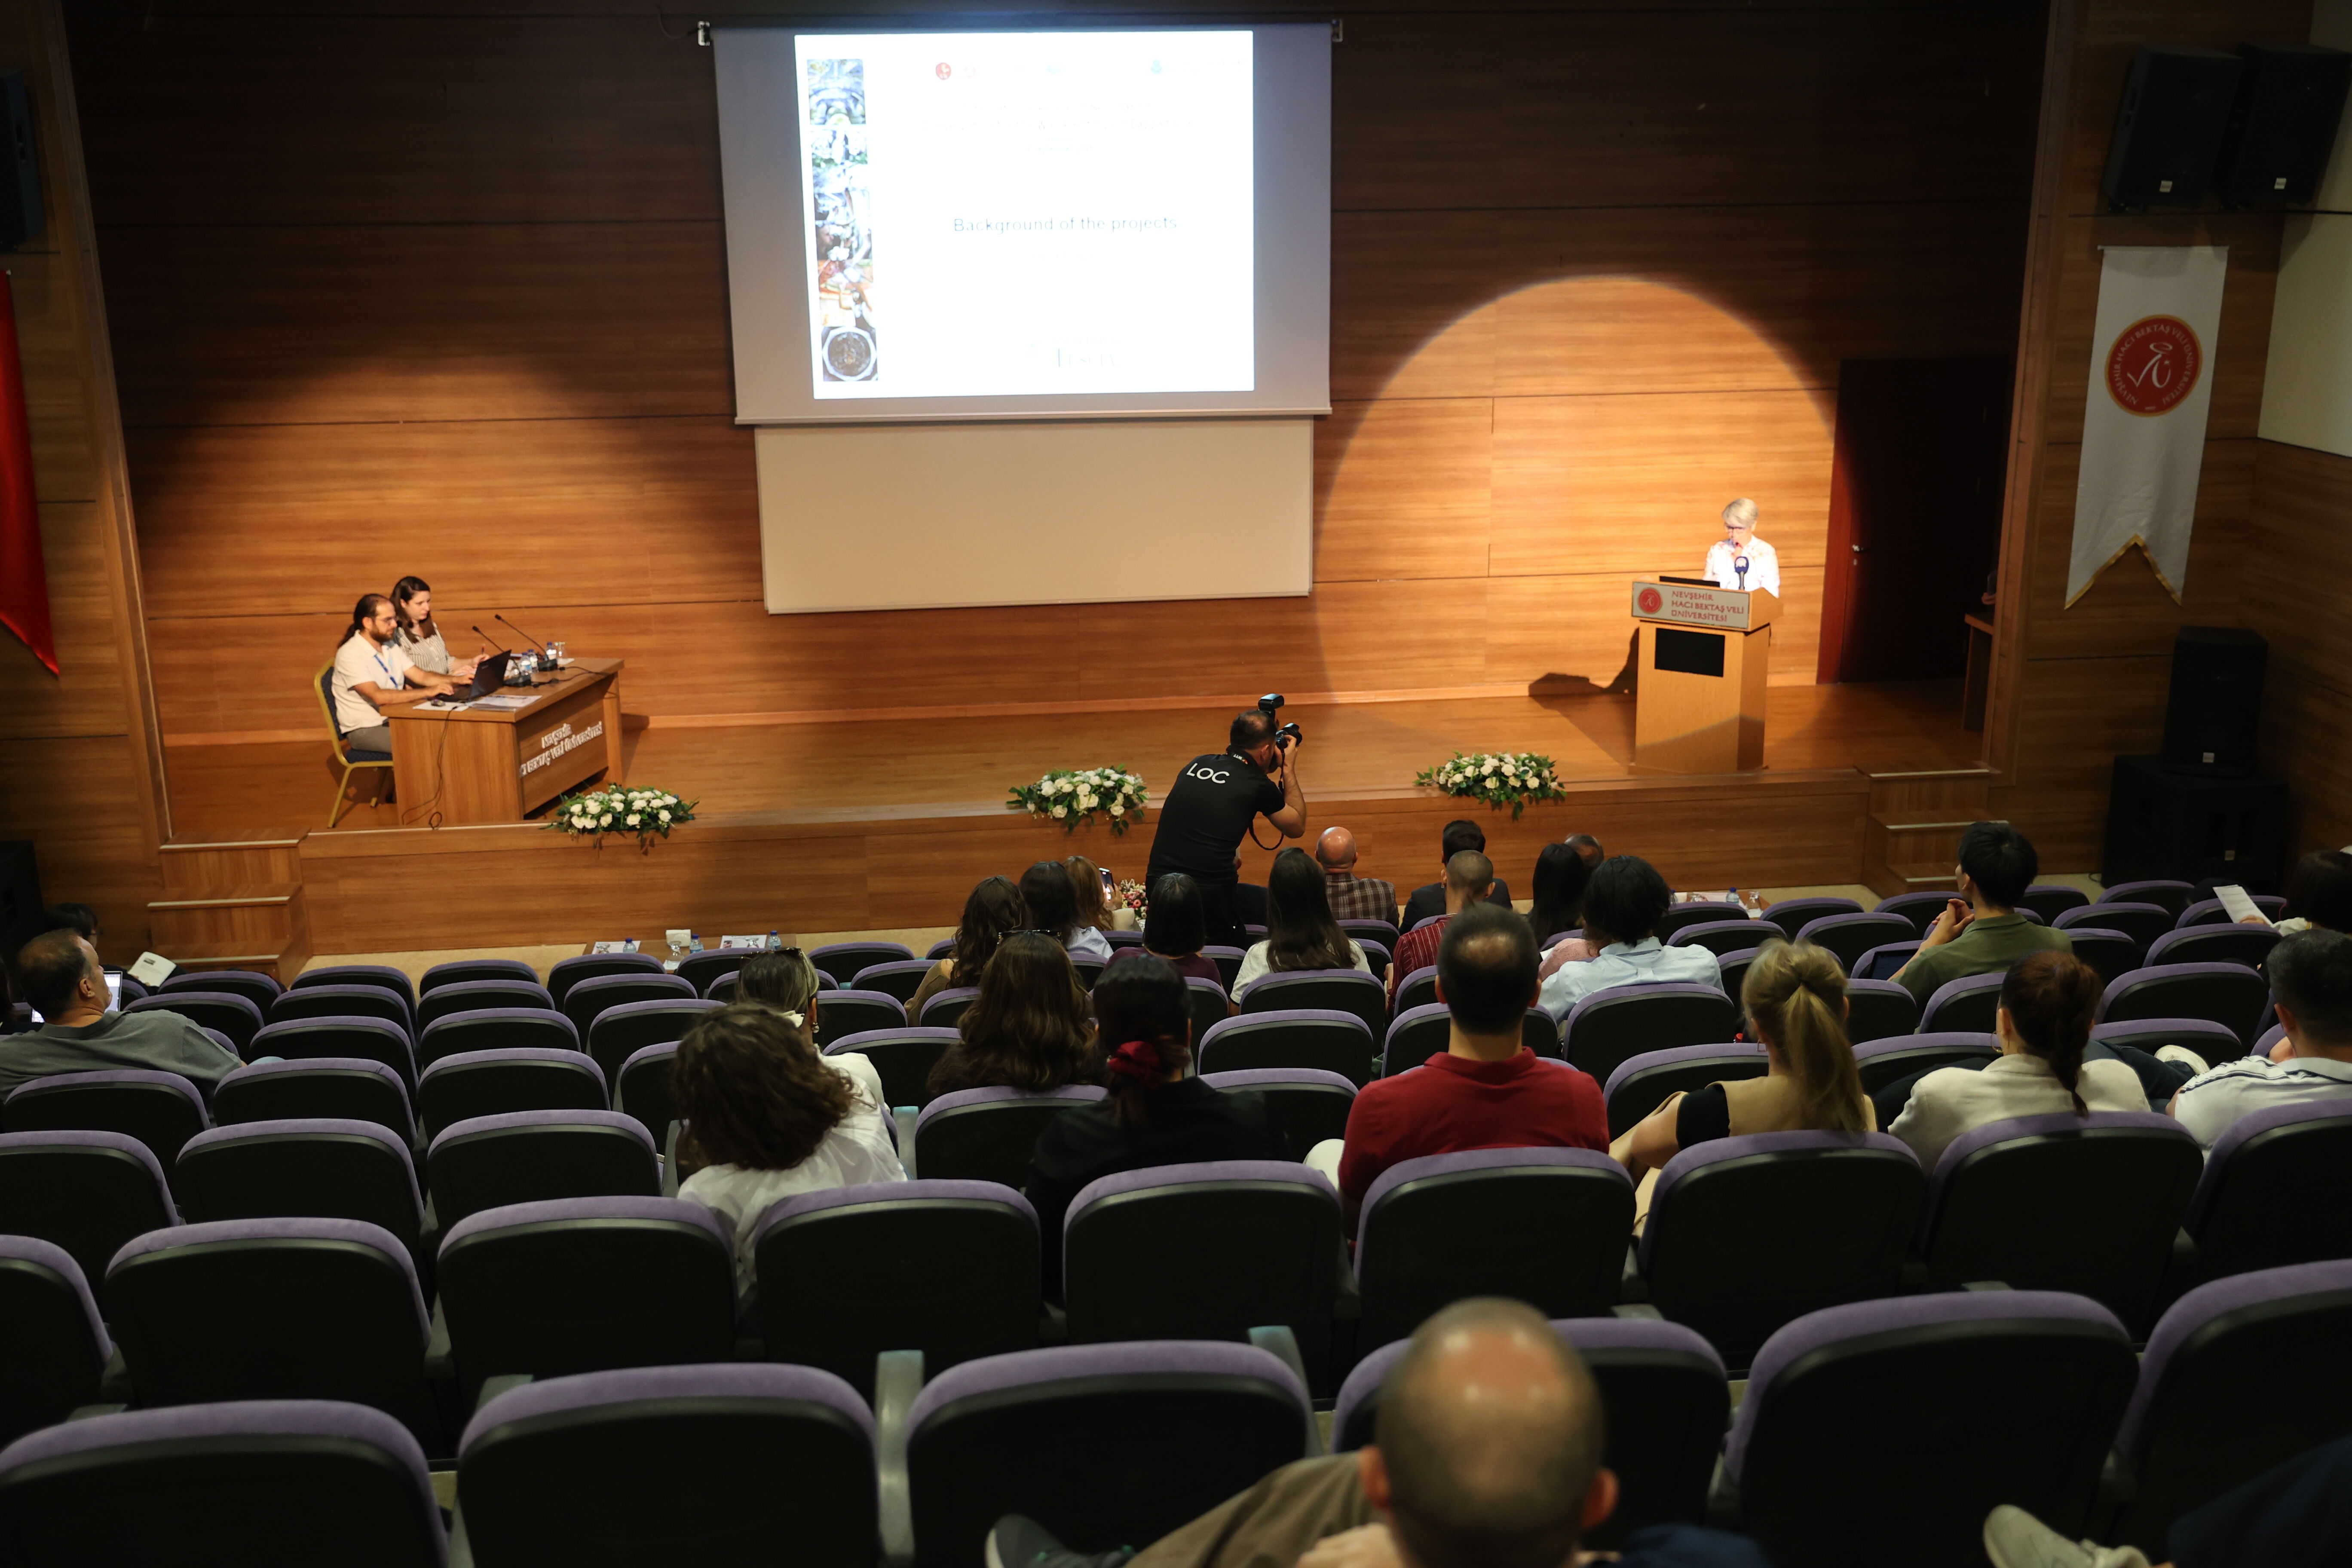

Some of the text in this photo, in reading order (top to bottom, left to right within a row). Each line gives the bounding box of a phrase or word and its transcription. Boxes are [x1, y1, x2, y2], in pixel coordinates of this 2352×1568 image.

[954, 217, 1177, 234] Background of the projects
[1672, 591, 1713, 600] NEVŞEHİR
[1695, 603, 1724, 613] BEKTAŞ
[1186, 763, 1230, 784] LOC
